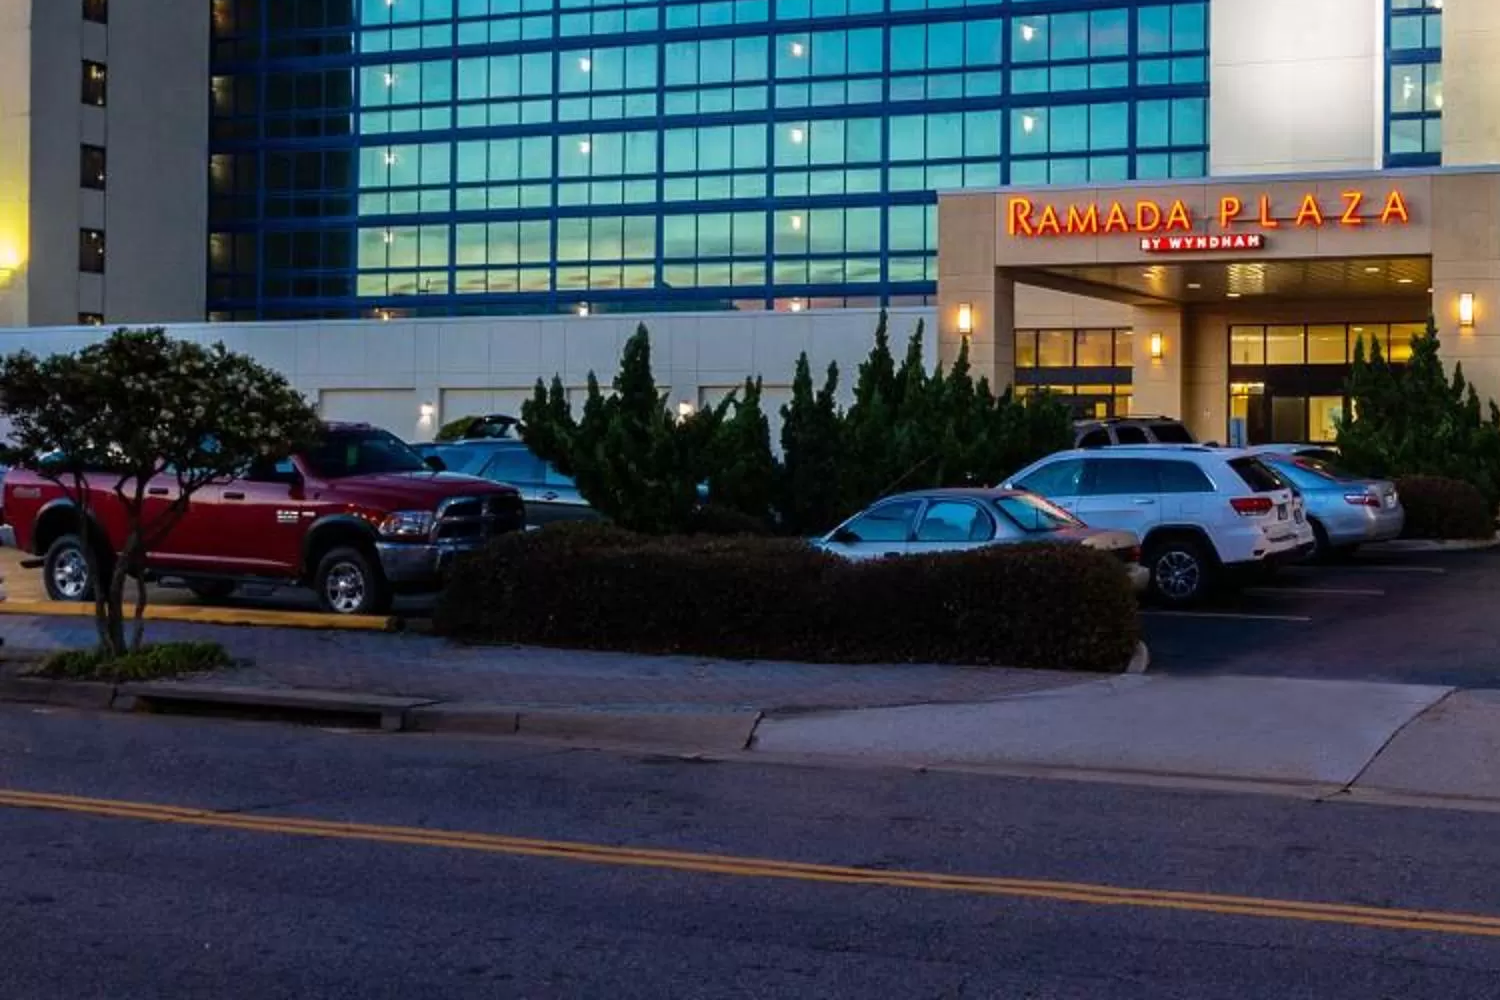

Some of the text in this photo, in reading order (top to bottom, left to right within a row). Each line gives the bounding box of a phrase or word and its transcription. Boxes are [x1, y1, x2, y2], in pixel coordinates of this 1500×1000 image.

[1007, 190, 1409, 236] RAMADA PLAZA
[1141, 235, 1260, 250] BY WYNDHAM
